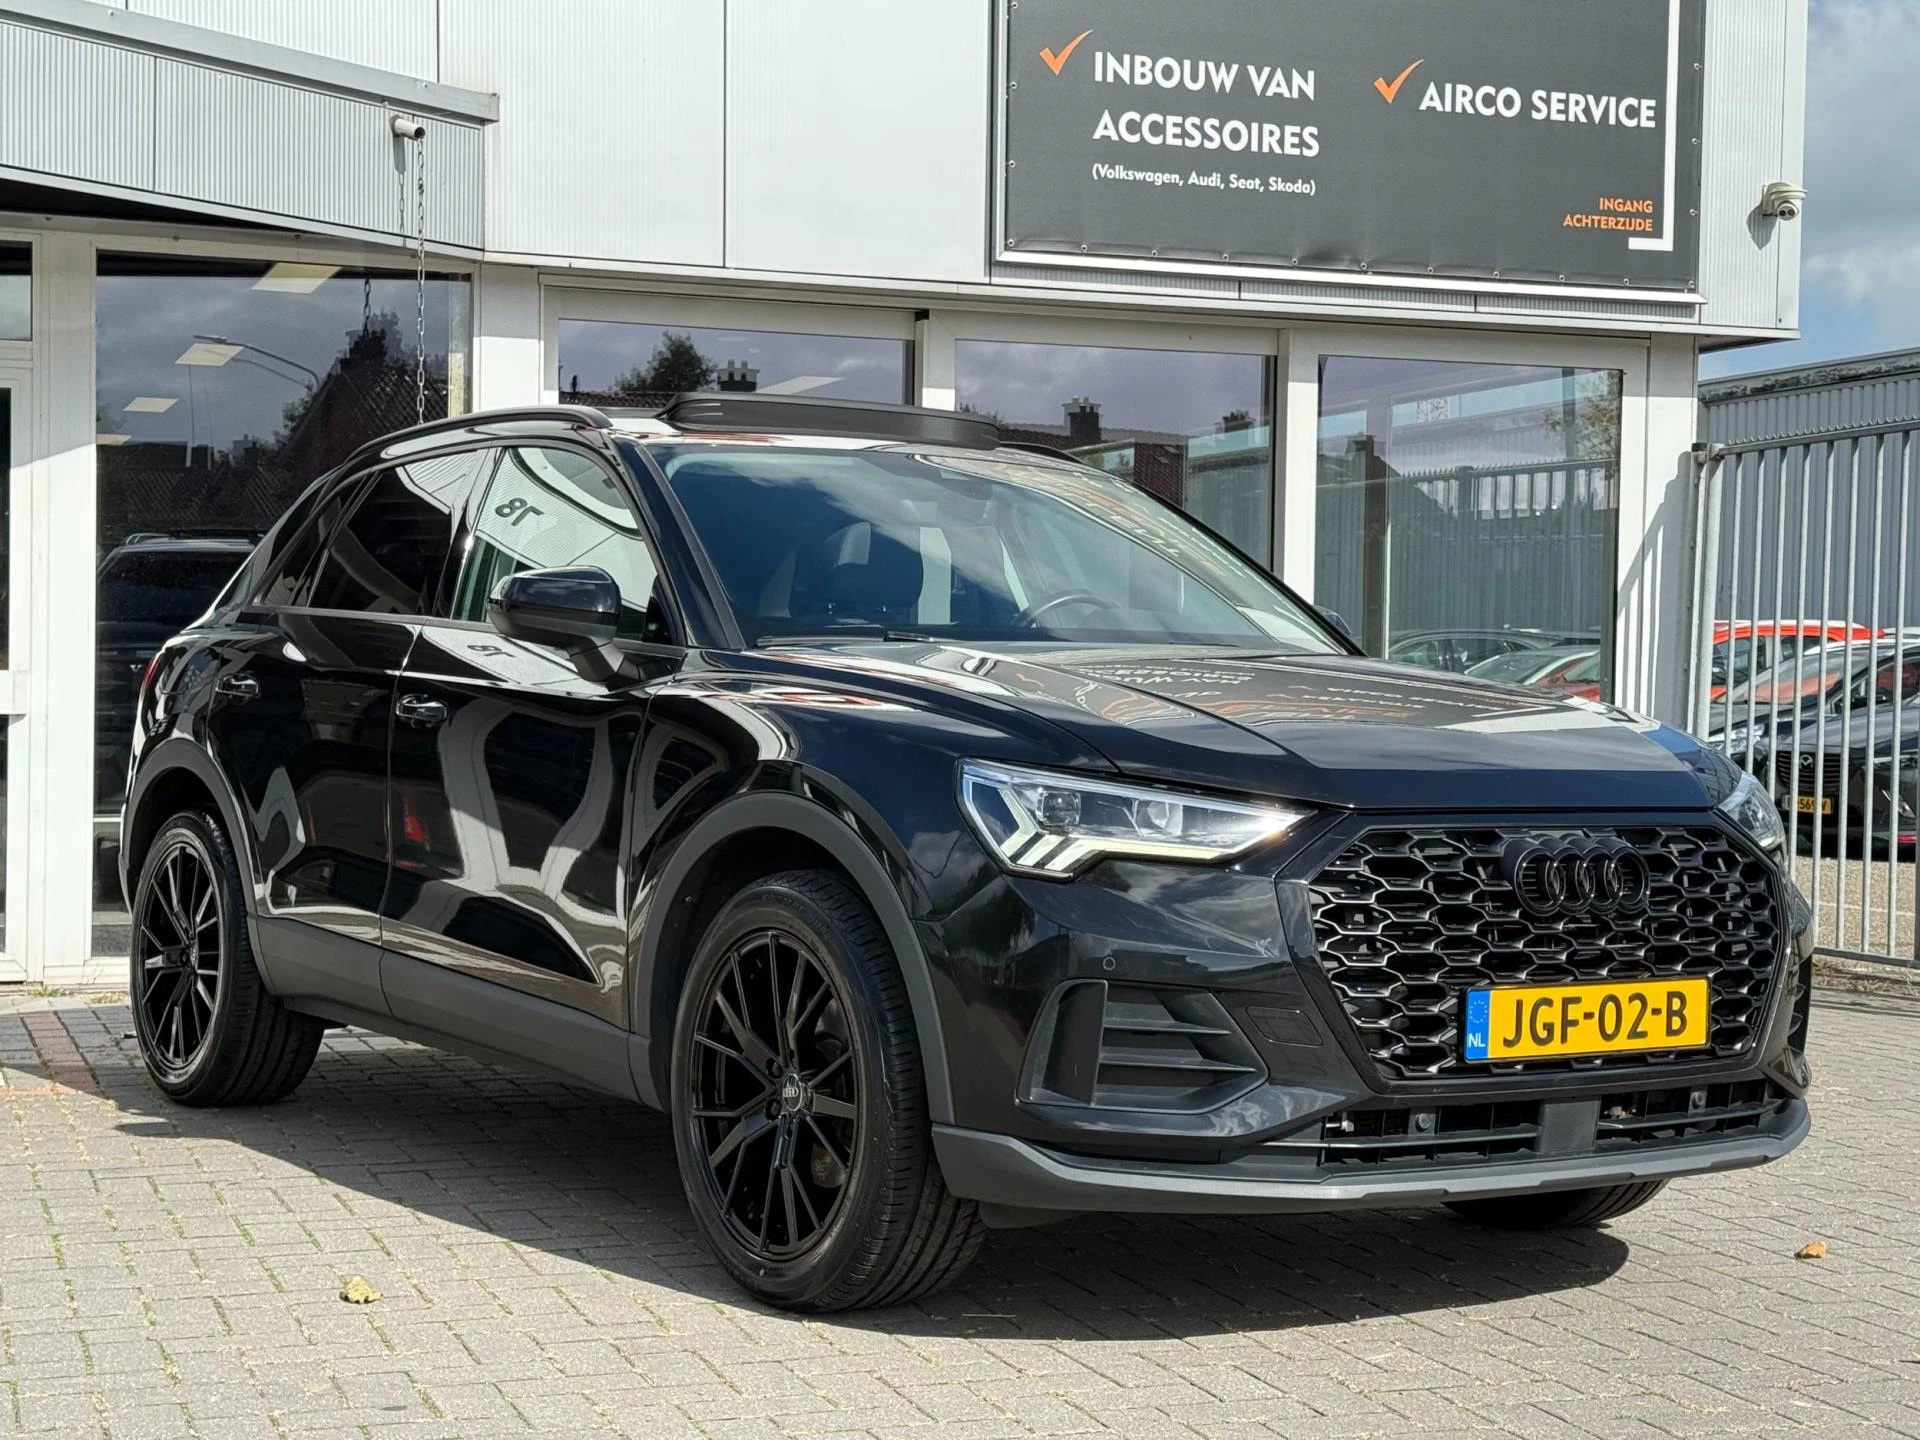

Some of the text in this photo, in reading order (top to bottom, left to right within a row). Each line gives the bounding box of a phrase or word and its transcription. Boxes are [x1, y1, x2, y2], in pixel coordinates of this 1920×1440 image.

[1094, 51, 1315, 101] INBOUW VAN
[1418, 81, 1656, 128] AIRCO SERVICE
[1092, 109, 1320, 157] ACCESSOIRES
[1092, 163, 1316, 196] (Volkswagen, Audi, Seat, Skoda)
[1562, 214, 1653, 231] ACHTERZIJDE
[1599, 197, 1653, 213] INGANG
[1502, 991, 1688, 1049] JGF-02-B
[1468, 1033, 1486, 1048] NL
